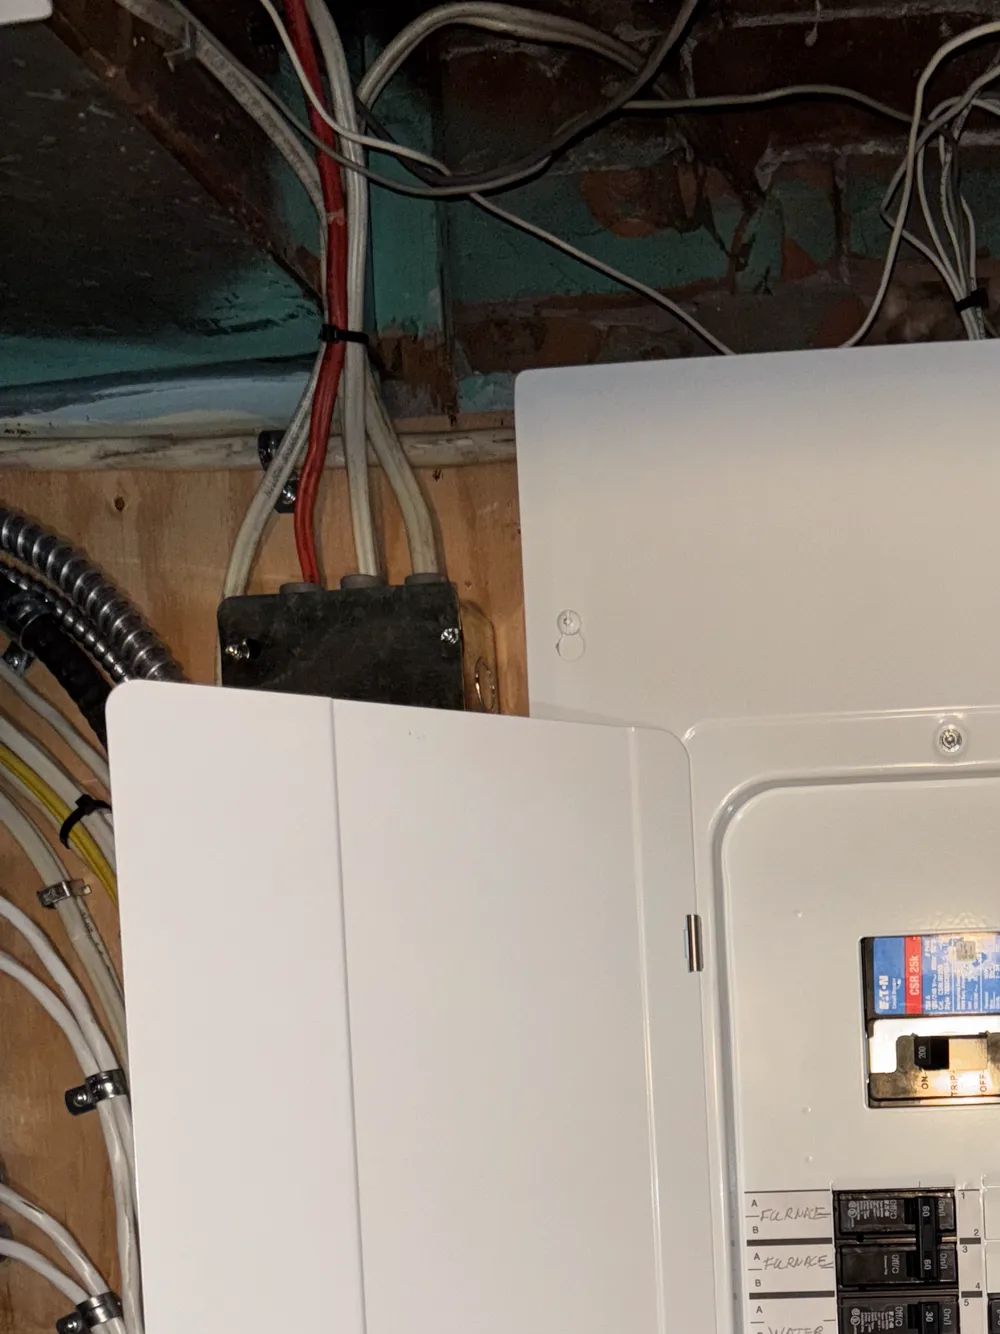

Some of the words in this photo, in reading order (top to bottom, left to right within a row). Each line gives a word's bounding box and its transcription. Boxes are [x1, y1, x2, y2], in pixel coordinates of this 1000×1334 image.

[909, 975, 919, 995] CSR
[918, 1046, 926, 1059] 200
[921, 1076, 929, 1089] ON
[950, 1075, 958, 1096] TRIP
[980, 1074, 988, 1092] OFF
[751, 1199, 758, 1208] A
[760, 1207, 829, 1221] FURNACE
[752, 1225, 760, 1235] B
[763, 1255, 833, 1270] FURNACE
[755, 1305, 763, 1314] A
[925, 1311, 934, 1323] 30
